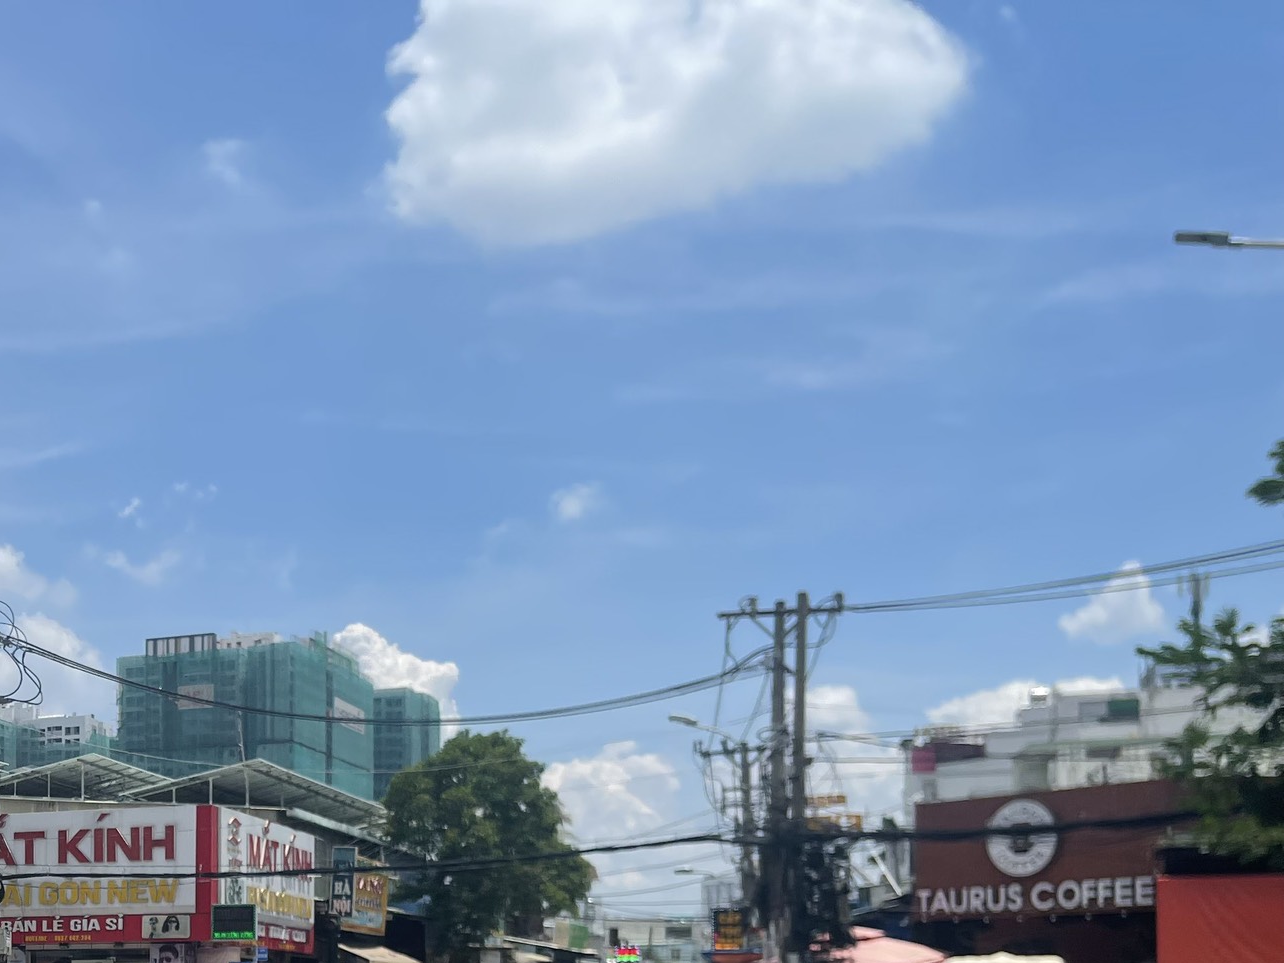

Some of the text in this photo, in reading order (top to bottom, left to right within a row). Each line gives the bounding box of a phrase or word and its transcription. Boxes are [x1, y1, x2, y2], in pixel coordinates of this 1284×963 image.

[57, 812, 176, 864] KÍNH
[247, 819, 313, 881] MẮT KÍNH
[107, 878, 180, 904] NEW
[332, 896, 352, 917] NỘI
[916, 875, 1155, 915] TAURUS COFFEE
[0, 916, 36, 933] BÁN
[41, 915, 65, 932] LẺ
[69, 915, 101, 932] GÍA
